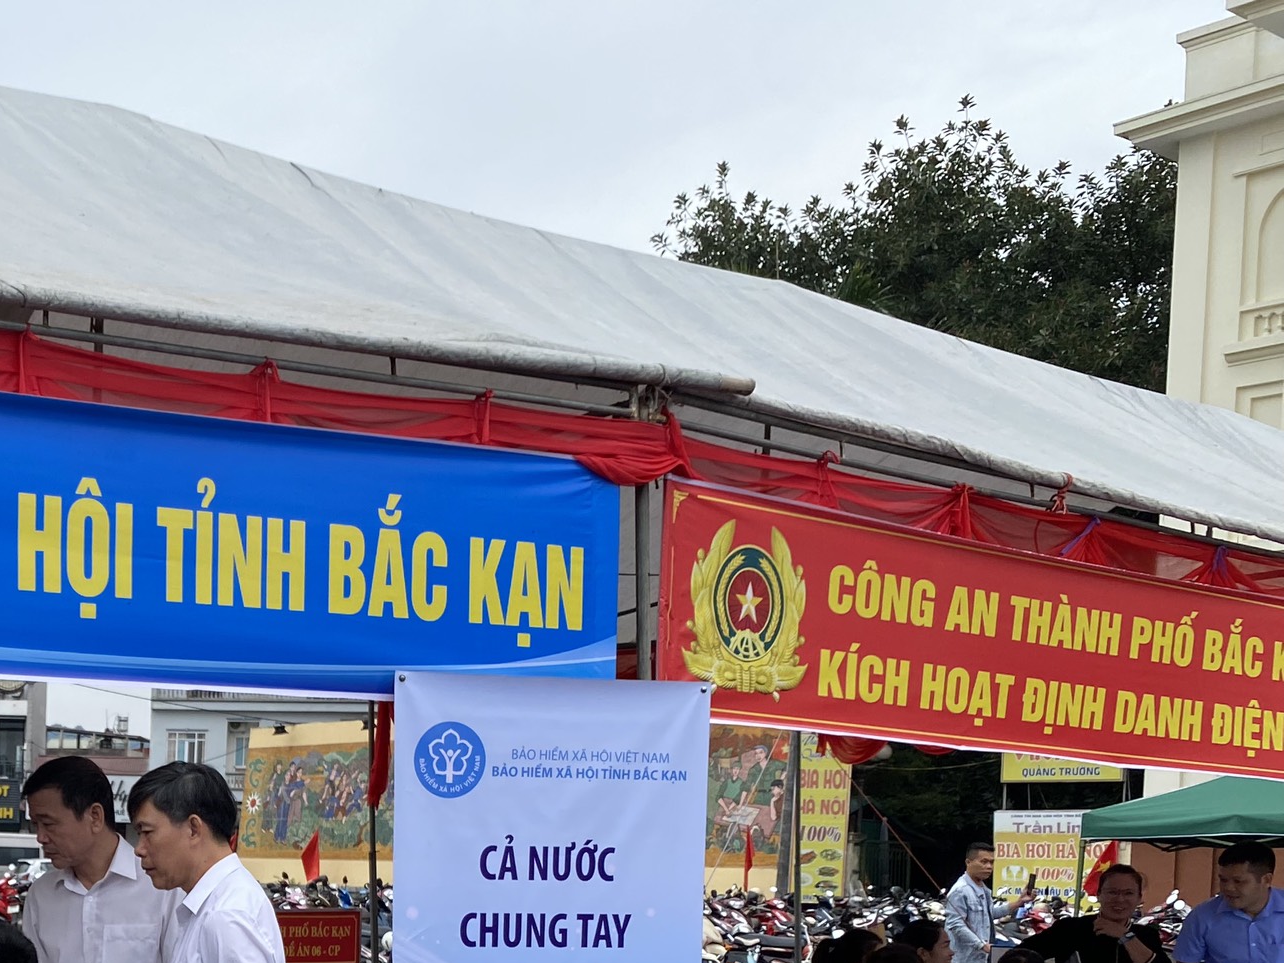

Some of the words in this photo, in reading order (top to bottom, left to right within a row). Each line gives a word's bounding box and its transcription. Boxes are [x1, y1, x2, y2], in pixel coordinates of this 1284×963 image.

[18, 477, 132, 619] HỘI
[157, 478, 305, 611] TỈNH
[329, 494, 447, 622] BẮC
[469, 537, 584, 647] KẠN
[828, 559, 936, 628] CÔNG
[944, 586, 999, 638] AN
[1010, 594, 1122, 657] THÀNH
[1129, 611, 1199, 667] PHỐ
[1202, 618, 1264, 679] BẮC
[817, 642, 910, 707] KÍCH
[920, 662, 1015, 727] HOẠT
[1021, 677, 1106, 736] ĐỊNH
[1113, 690, 1202, 742] DANH
[1211, 699, 1284, 759] ĐIỆN
[511, 746, 536, 760] BẢO
[539, 746, 569, 761] HIỂM
[571, 748, 588, 762] XÃ
[591, 748, 612, 764] HỘI
[614, 749, 640, 765] VIỆT
[641, 752, 670, 764] NAM
[491, 763, 518, 778] BẢO
[521, 763, 553, 778] HIỂM
[556, 765, 573, 779] XÃ
[576, 765, 599, 782] HỘI
[601, 765, 631, 780] TỈNH
[633, 766, 658, 781] BẮC
[661, 770, 687, 784] KẠN
[1057, 822, 1081, 834] Lin
[479, 834, 518, 881] CẢ
[528, 839, 616, 882] NƯỚC
[996, 843, 1021, 859] BIA
[289, 922, 309, 938] PHỐ
[311, 921, 330, 938] BẮC
[331, 925, 351, 940] KẠN
[460, 912, 567, 948] CHUNG
[577, 913, 632, 949] TAY
[328, 945, 341, 957] CP
